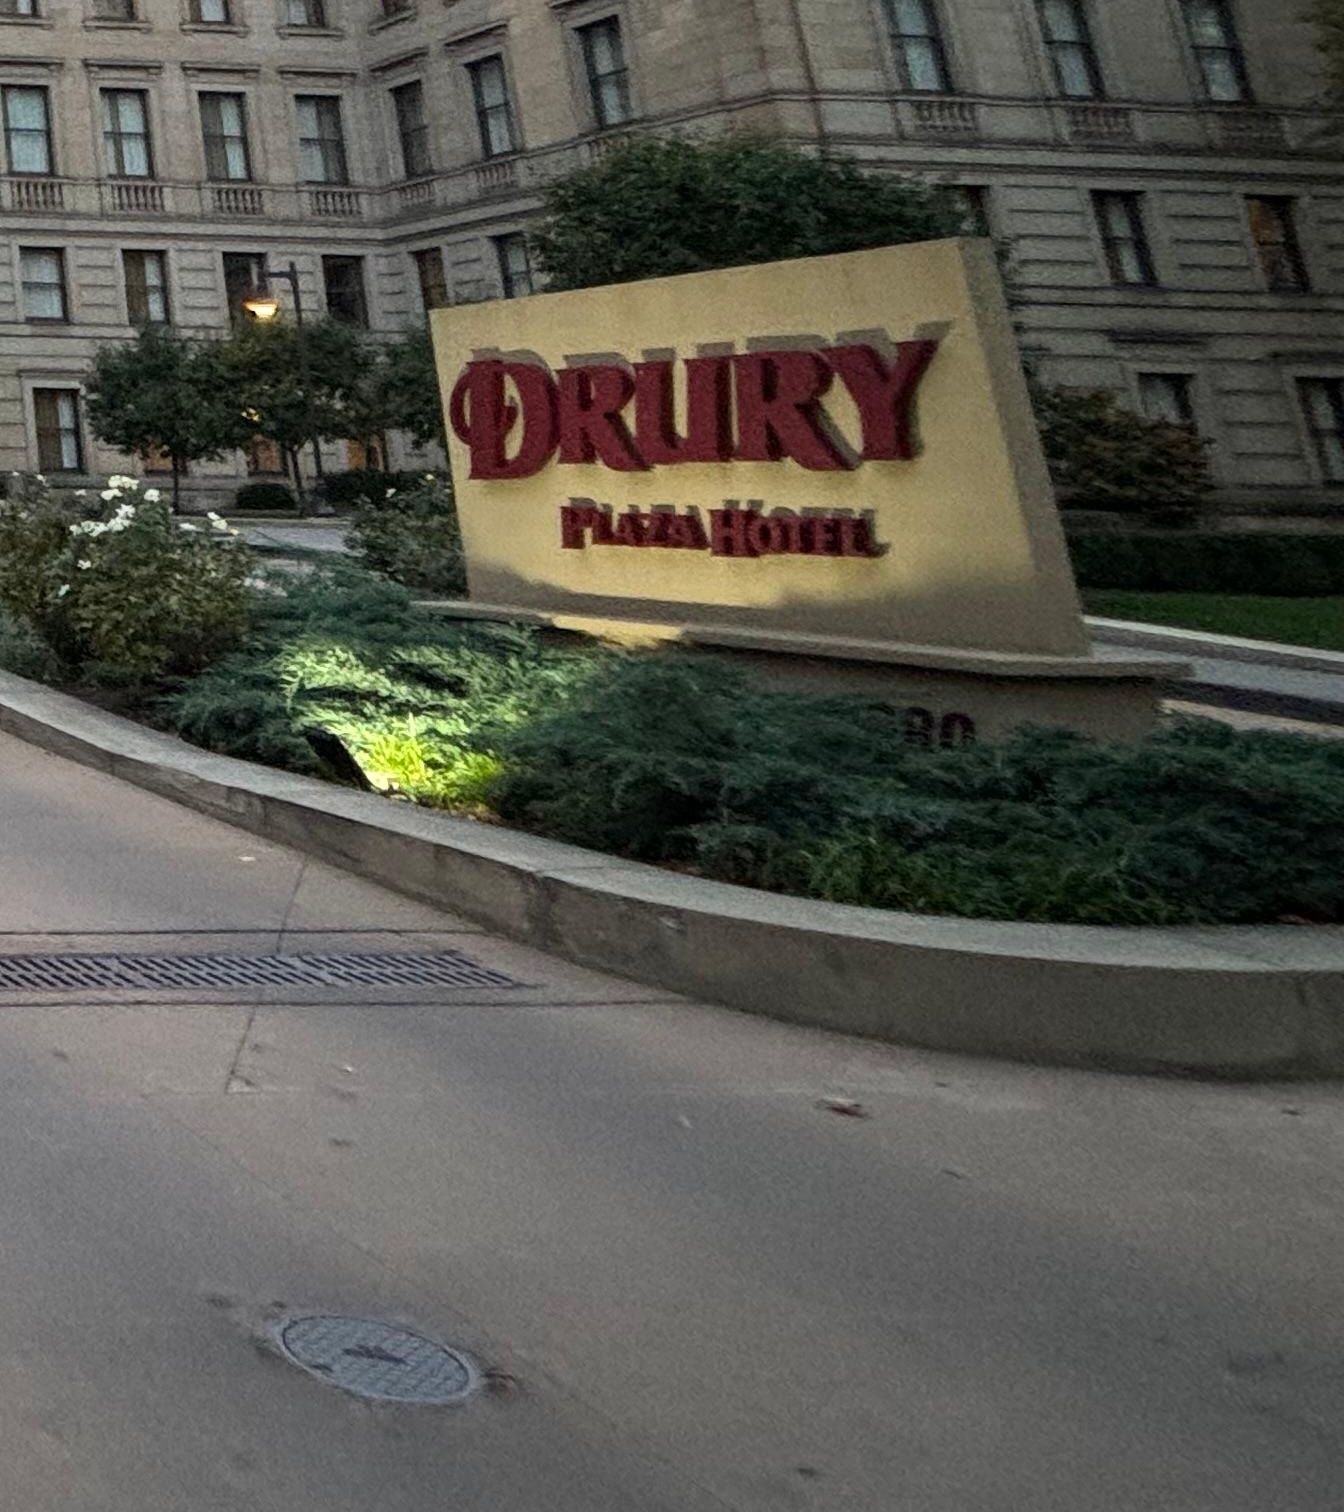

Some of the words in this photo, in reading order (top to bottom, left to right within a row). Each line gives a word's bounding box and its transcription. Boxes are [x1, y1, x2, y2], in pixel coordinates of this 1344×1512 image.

[449, 338, 941, 480] DRURY
[560, 503, 710, 549] PLAZA
[708, 506, 889, 558] HOTEL
